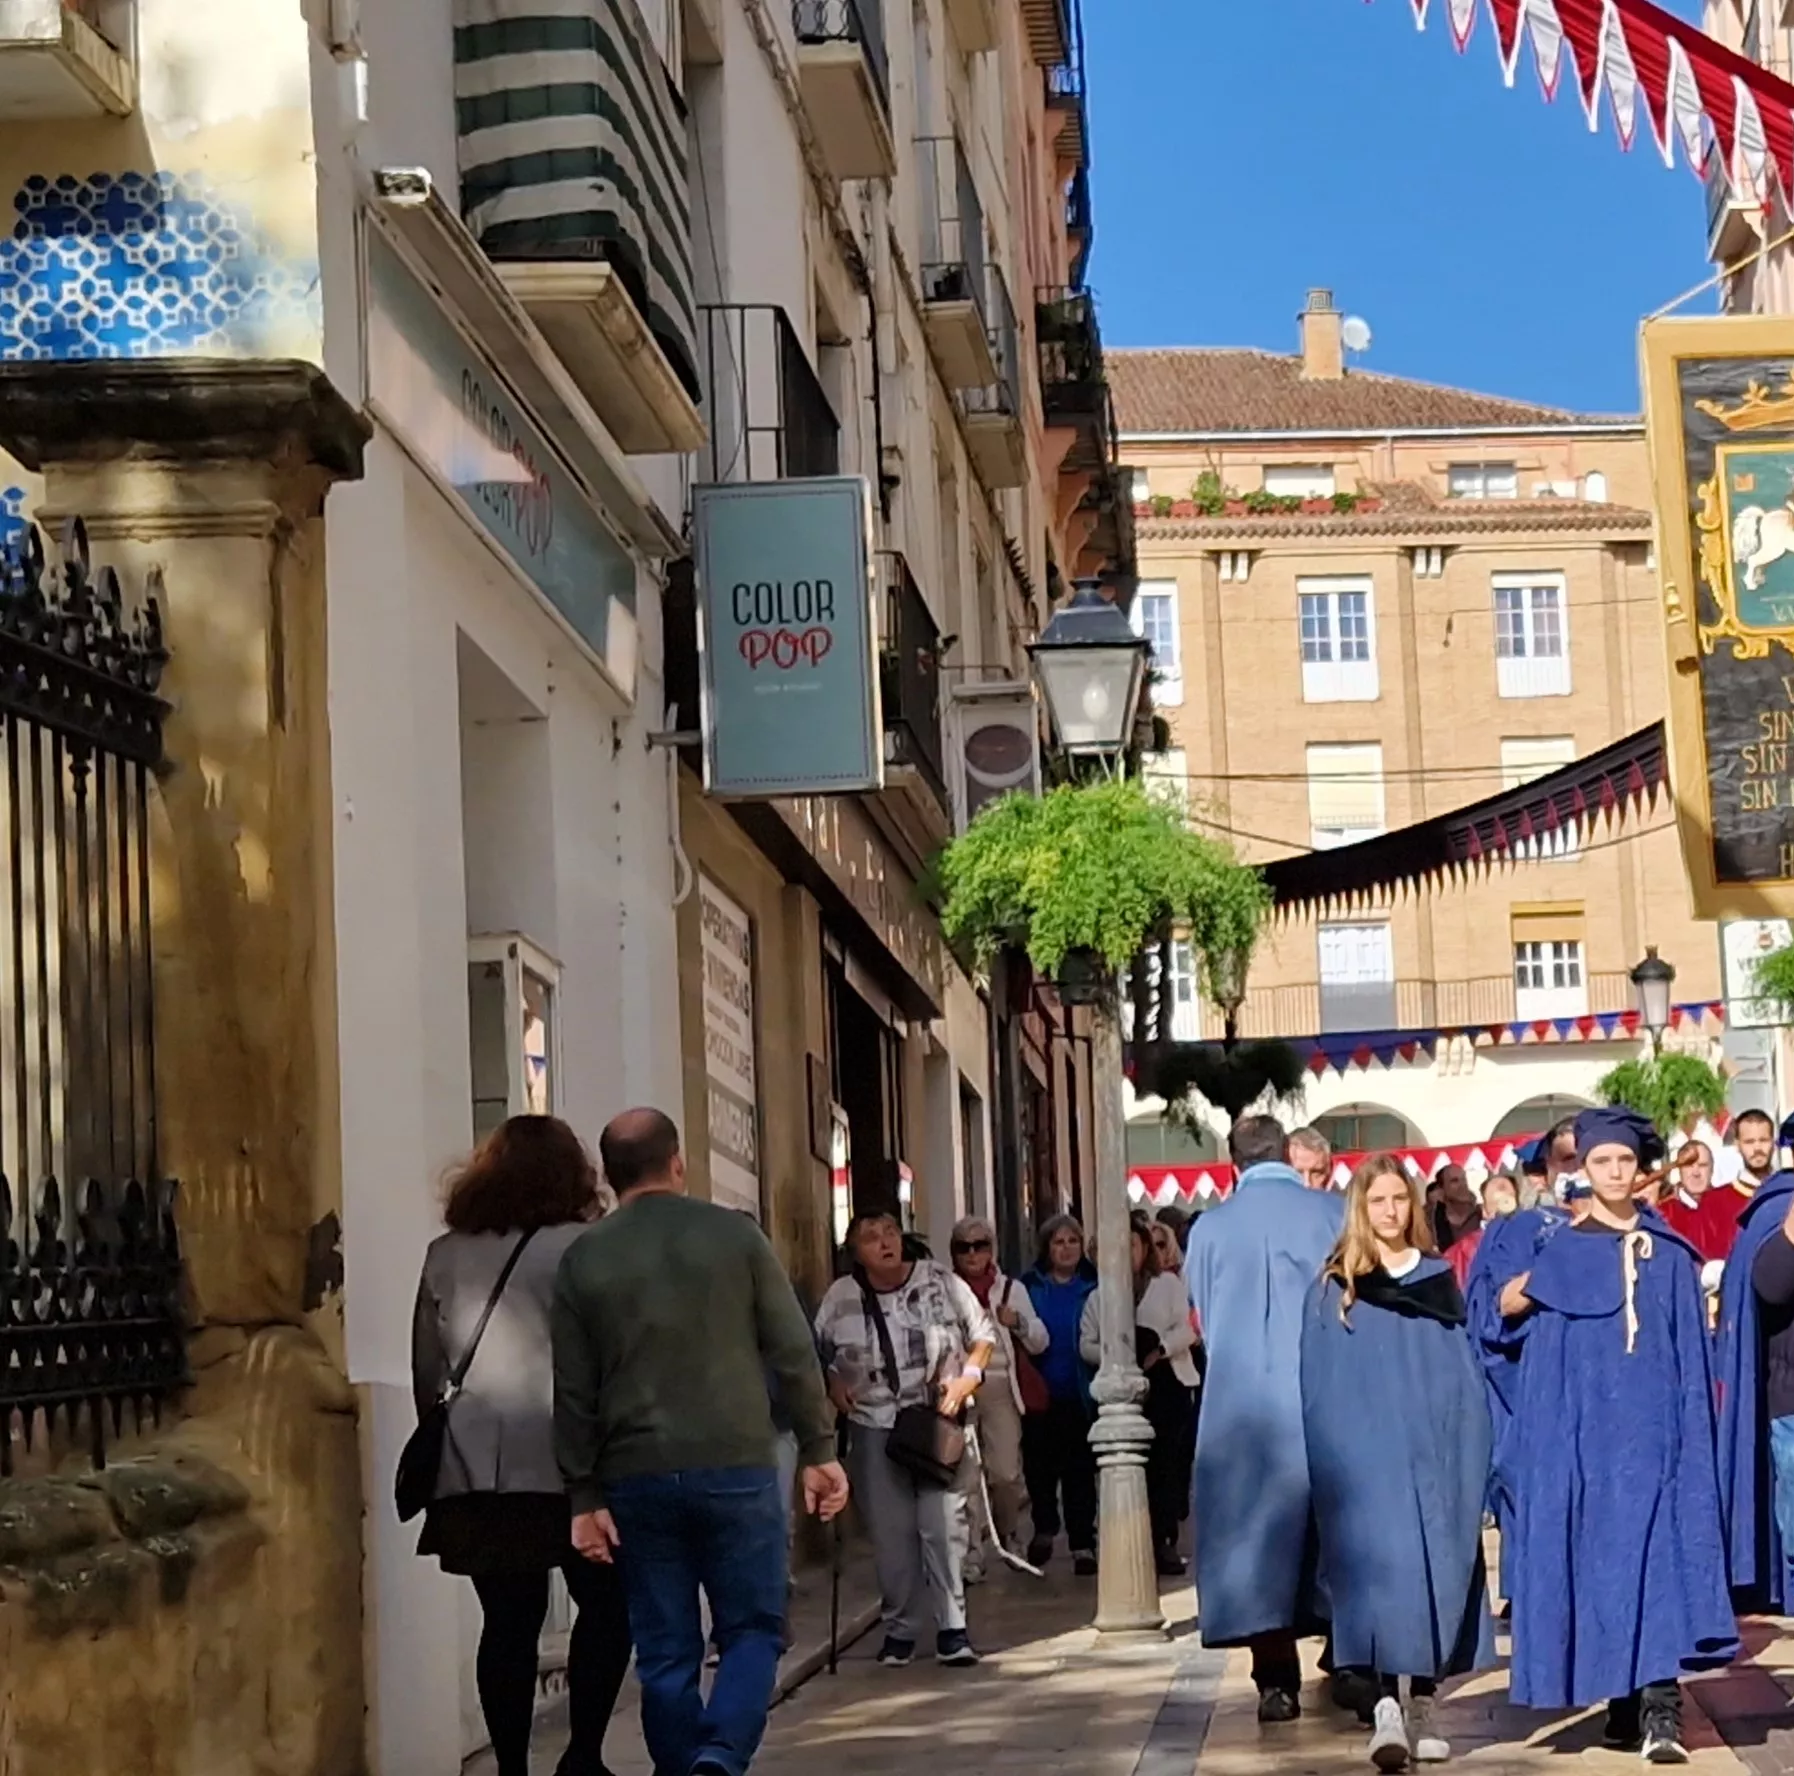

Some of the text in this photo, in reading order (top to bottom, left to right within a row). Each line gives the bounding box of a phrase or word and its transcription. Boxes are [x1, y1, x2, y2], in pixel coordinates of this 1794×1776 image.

[732, 579, 836, 626] COLOR
[739, 627, 833, 671] POP
[1741, 742, 1787, 775] SIN
[1739, 780, 1778, 811] SIN
